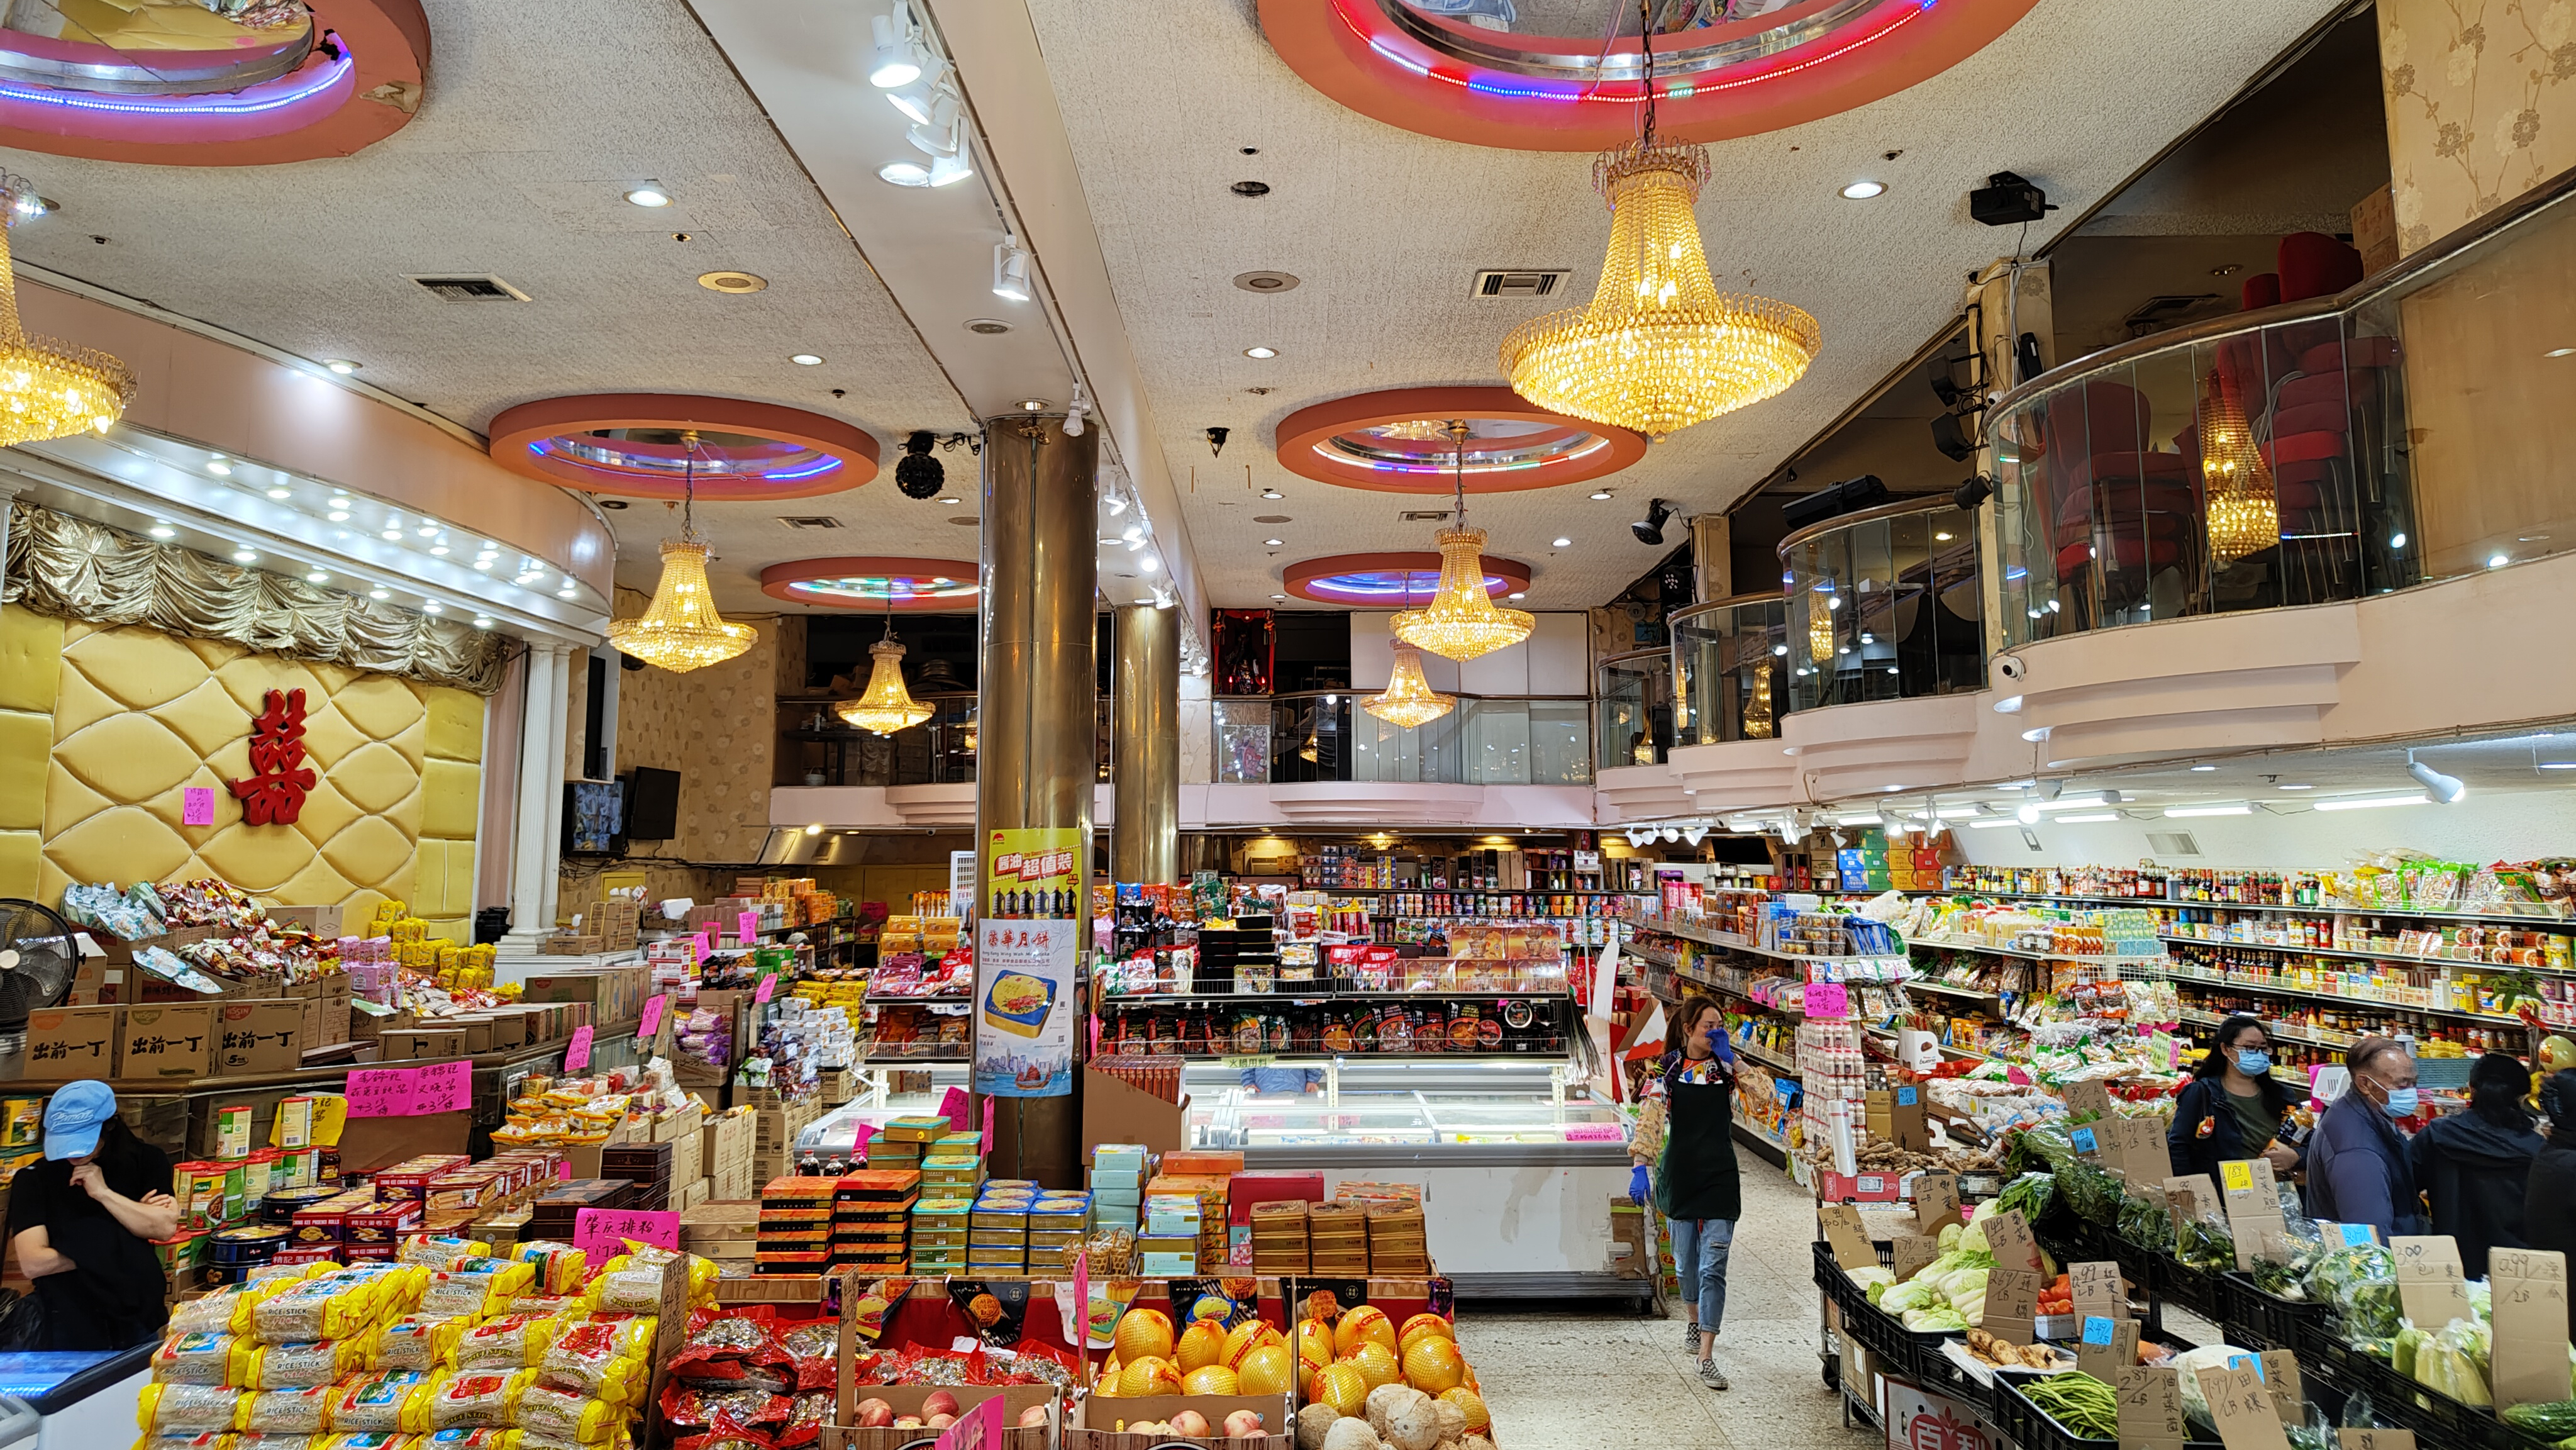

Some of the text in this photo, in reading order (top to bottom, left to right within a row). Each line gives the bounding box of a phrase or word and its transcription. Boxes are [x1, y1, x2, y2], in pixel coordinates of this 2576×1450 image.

[131, 1035, 204, 1056] 出前一丁
[222, 1030, 295, 1049] 出前一丁
[32, 1040, 107, 1061] 出前一丁
[1882, 1181, 1899, 1191] njoy
[415, 1252, 430, 1261] RICE
[2078, 1285, 2094, 1297] LB
[277, 1360, 321, 1370] RICE STICK
[567, 1368, 589, 1383] STICK
[286, 1406, 309, 1414] STICK
[527, 1404, 568, 1421] RICE STICK
[444, 1412, 494, 1427] RICE STICK
